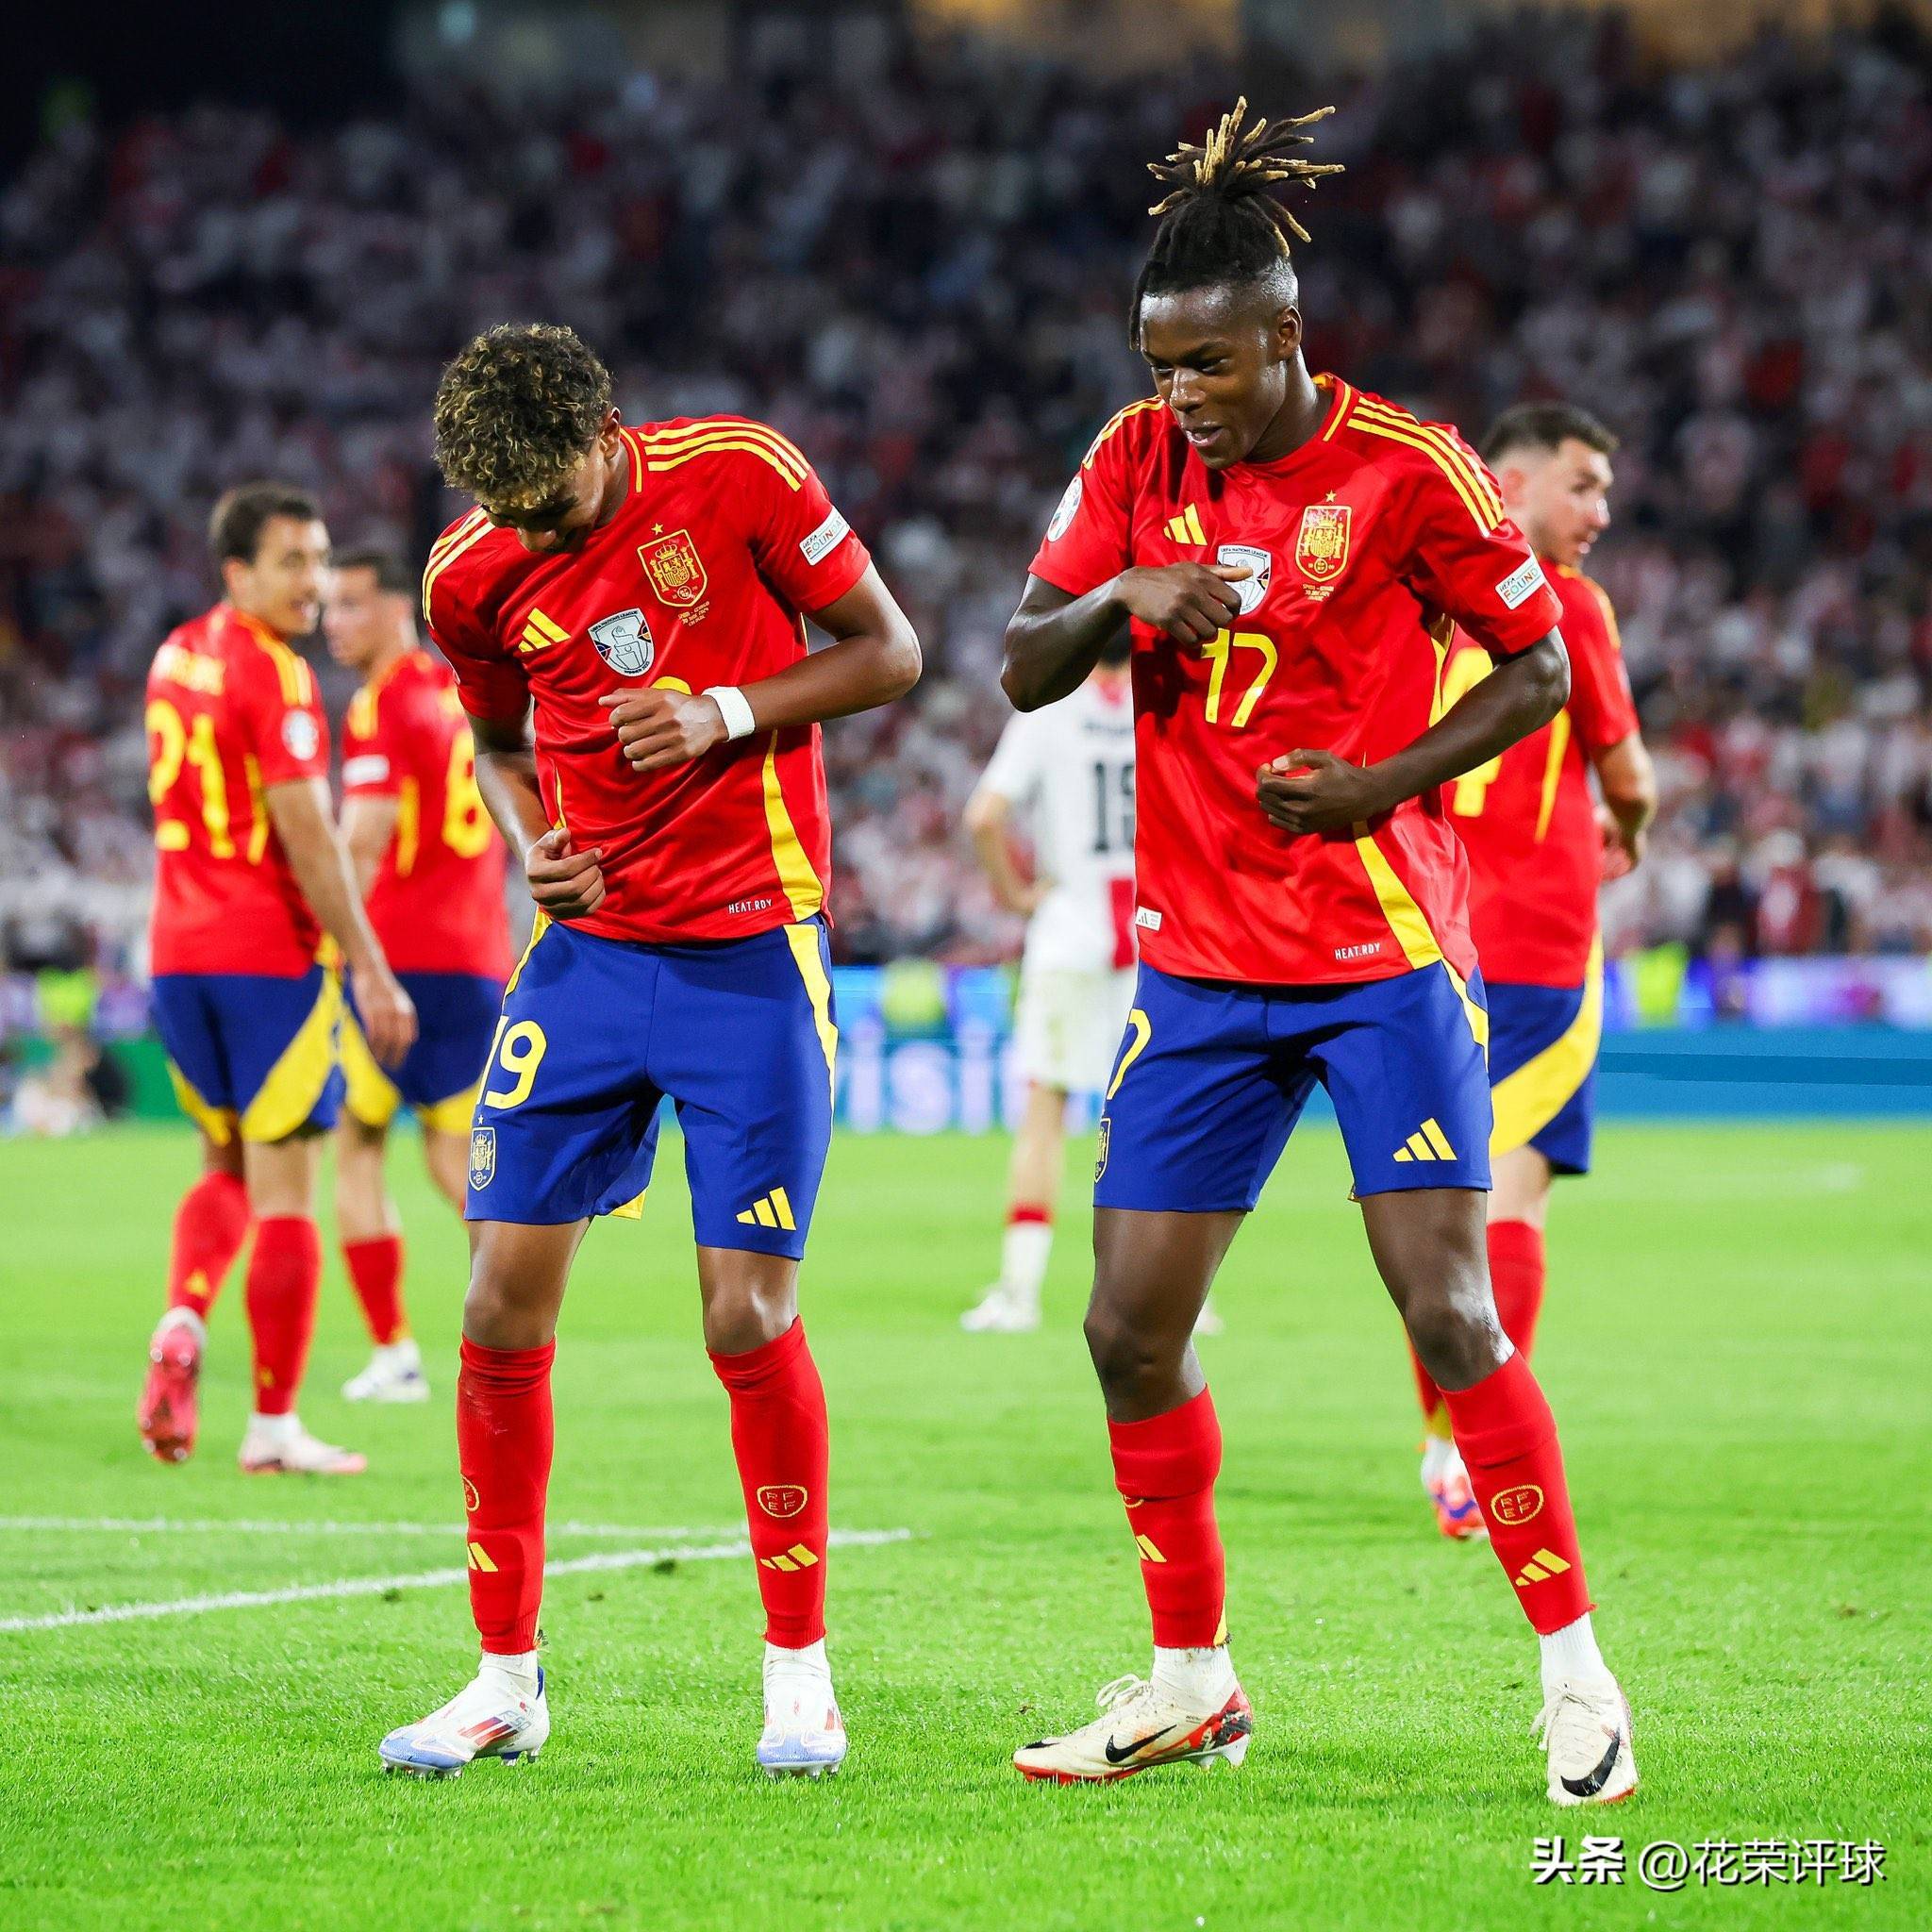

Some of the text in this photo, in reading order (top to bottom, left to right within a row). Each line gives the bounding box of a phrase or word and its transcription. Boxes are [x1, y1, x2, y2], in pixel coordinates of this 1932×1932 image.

[1201, 627, 1278, 727] 17
[146, 699, 235, 859] 21
[728, 898, 773, 914] HEAT.RDY
[1334, 941, 1381, 960] HEAT.RDY
[476, 1014, 547, 1109] 19
